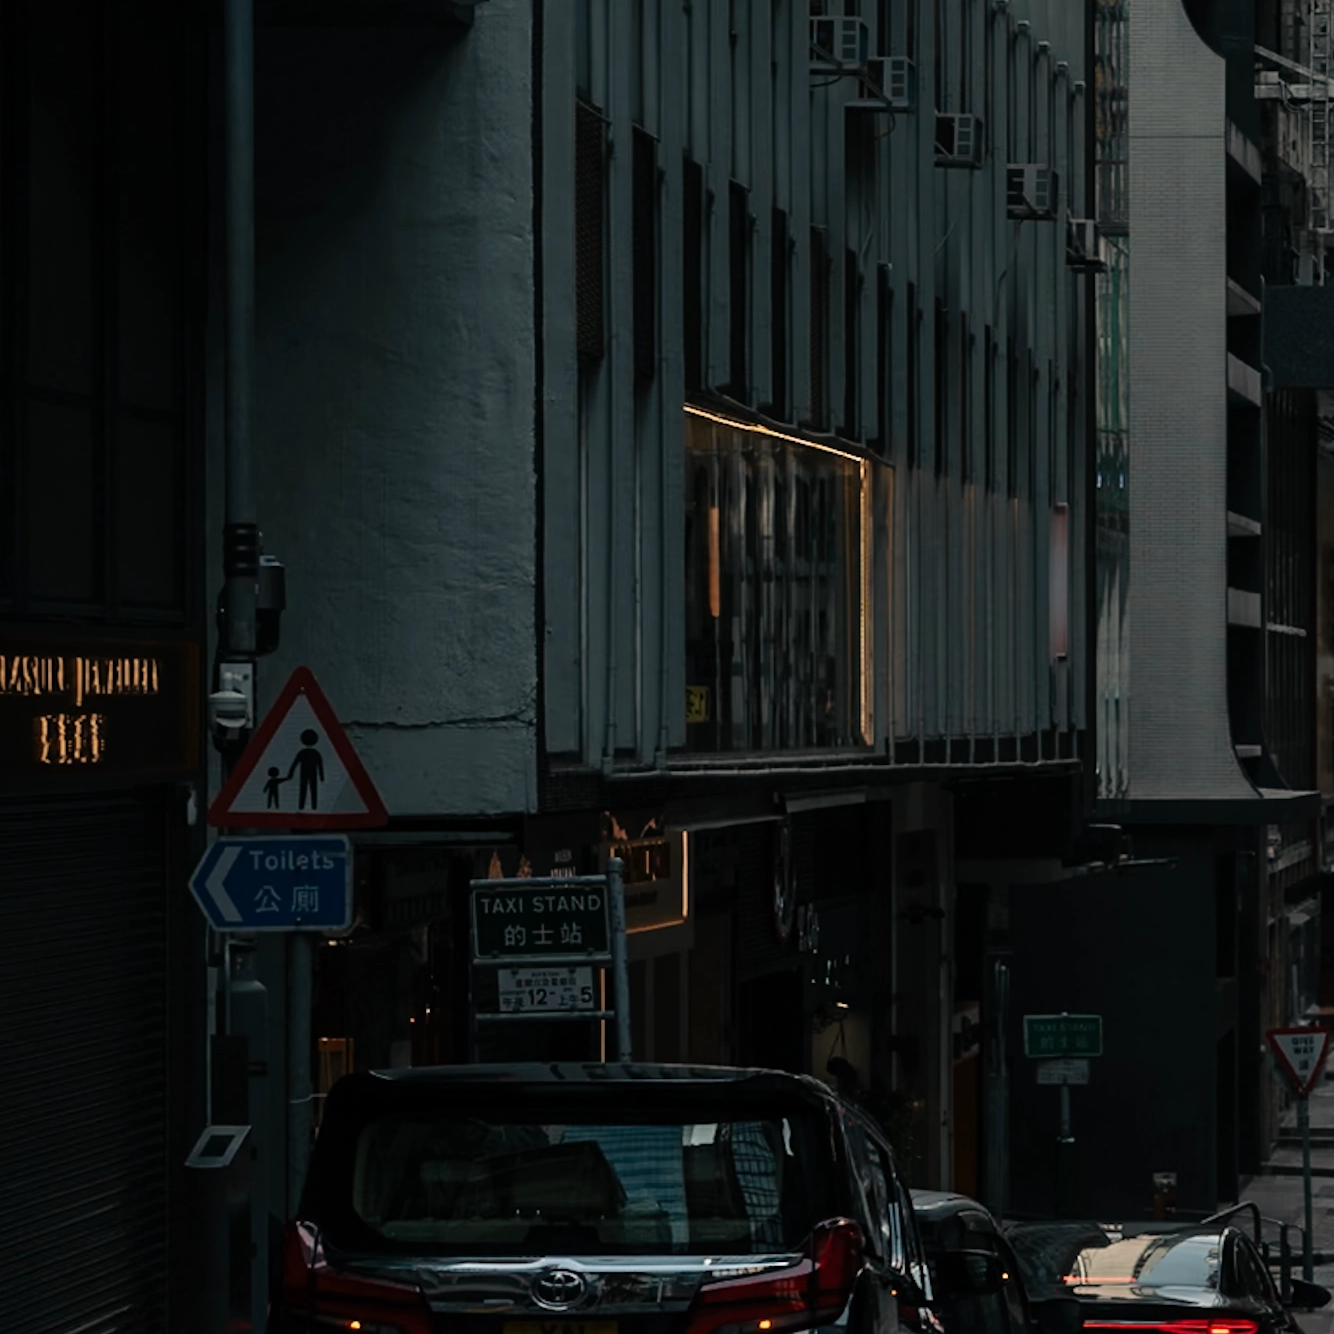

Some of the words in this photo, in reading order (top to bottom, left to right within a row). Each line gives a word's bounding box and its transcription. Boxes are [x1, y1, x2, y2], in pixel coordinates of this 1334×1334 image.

[248, 849, 335, 871] Toilets
[253, 883, 320, 914] 公廁
[480, 897, 524, 915] TAXI
[531, 895, 601, 914] STAND
[503, 922, 583, 947] 的士站
[528, 988, 548, 1005] 12
[581, 986, 592, 1003] 5
